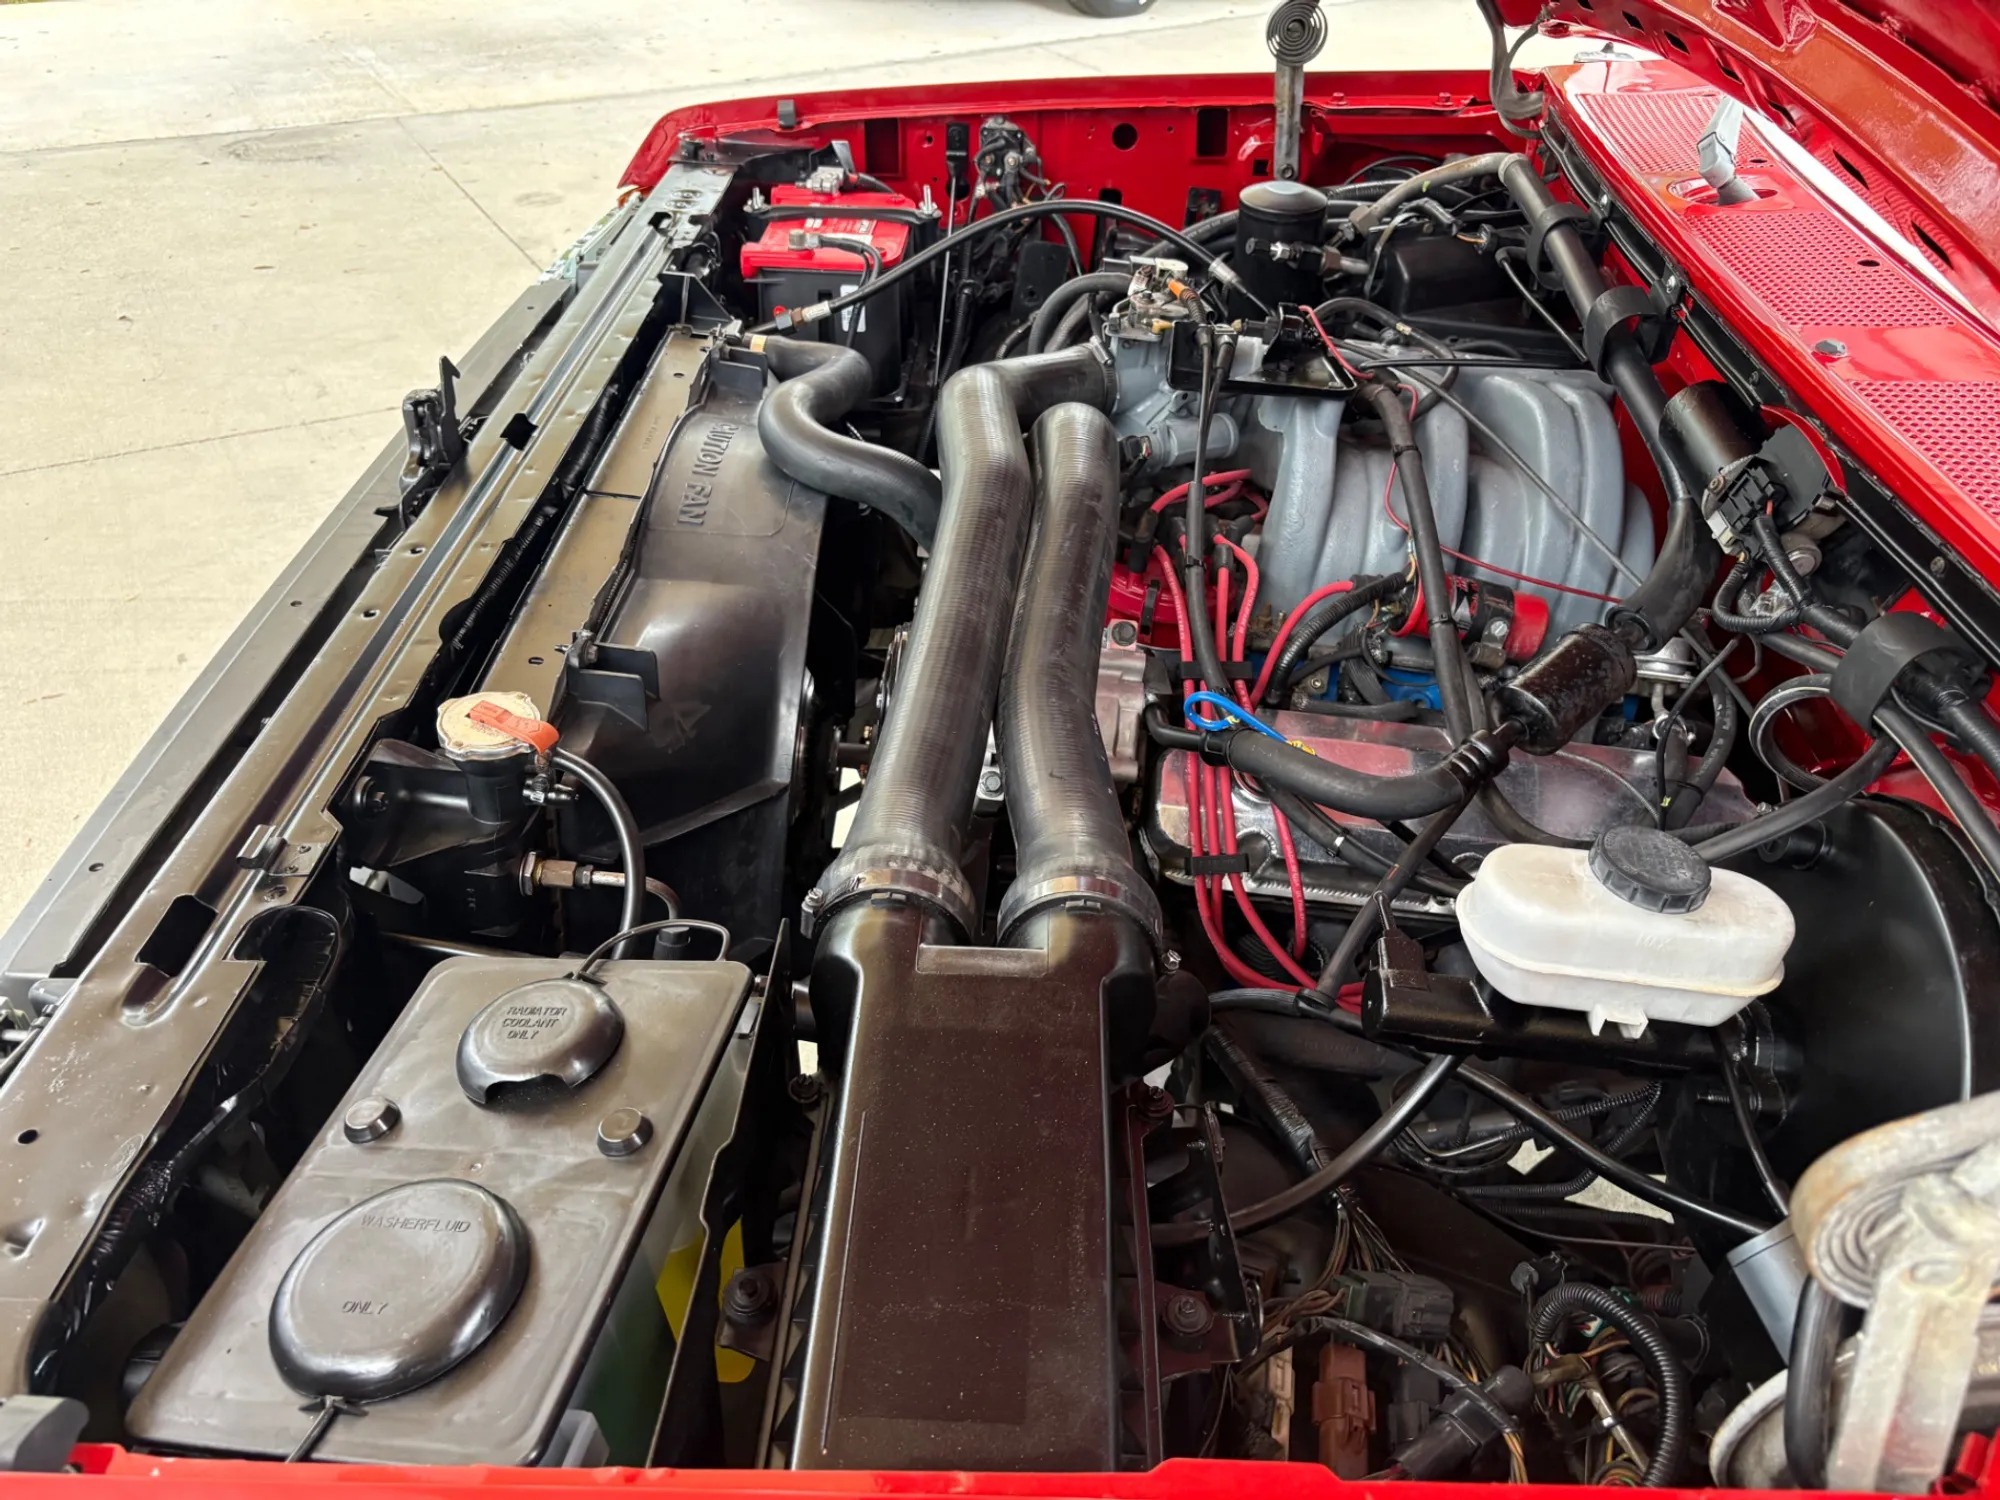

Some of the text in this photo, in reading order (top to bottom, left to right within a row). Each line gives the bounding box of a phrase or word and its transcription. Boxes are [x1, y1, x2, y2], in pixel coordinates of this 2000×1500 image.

[677, 423, 739, 525] CAUTION FAN
[506, 1006, 567, 1016] RADIATOR
[502, 1018, 560, 1028] COOLANT
[507, 1030, 539, 1040] ONLY
[342, 1300, 389, 1315] ONLY
